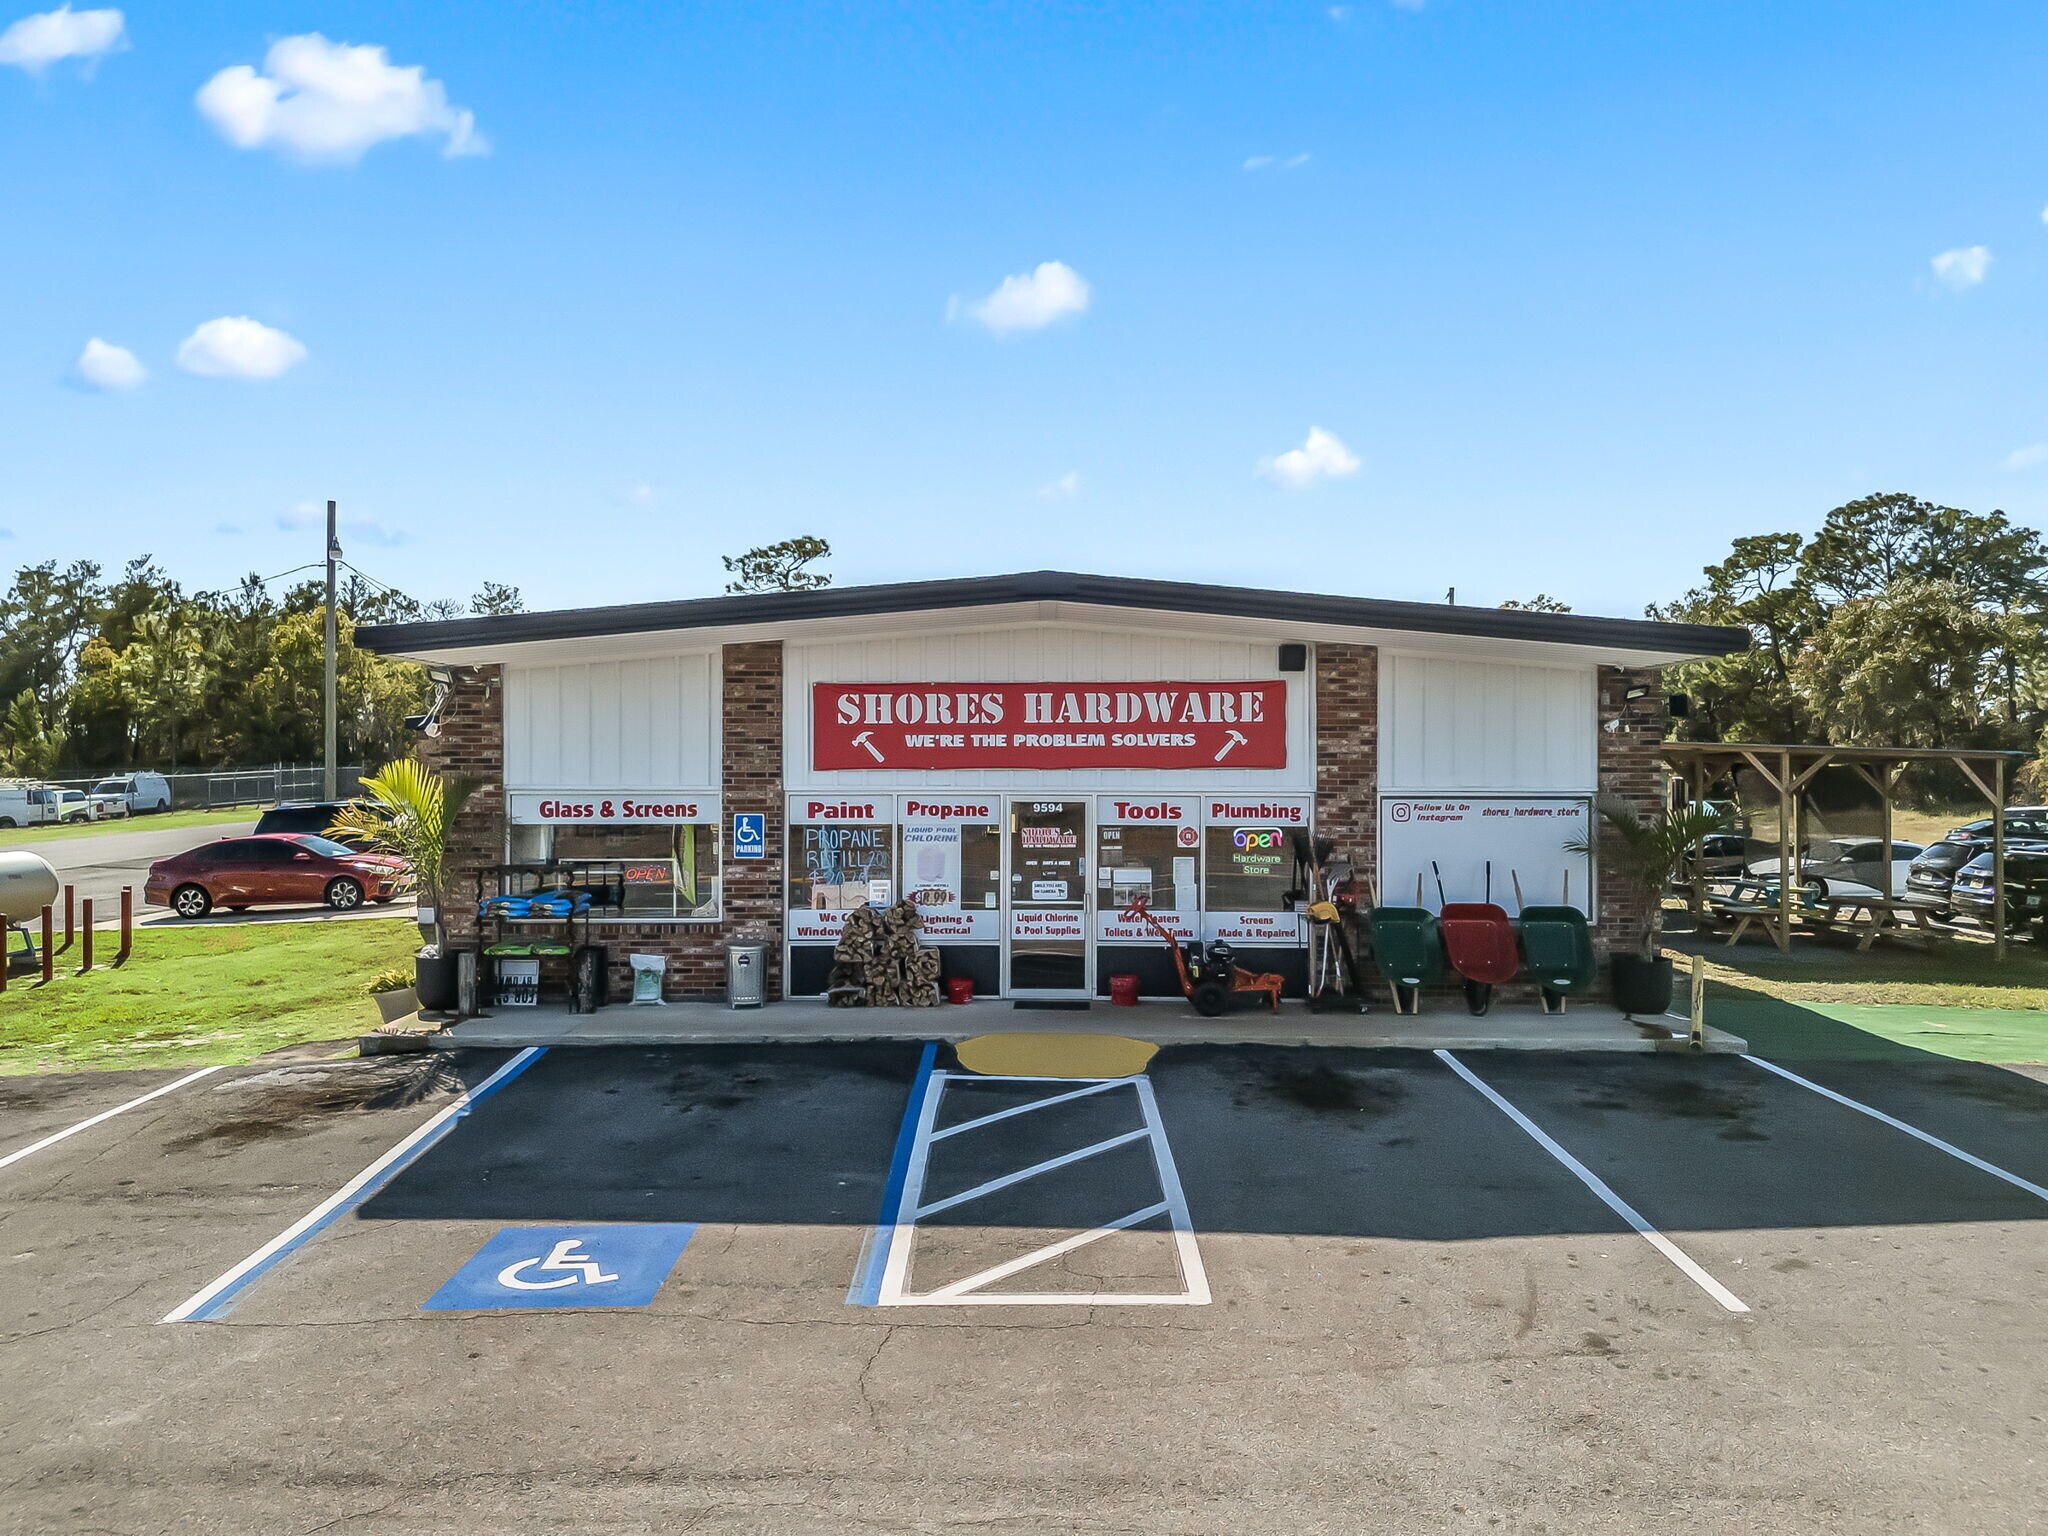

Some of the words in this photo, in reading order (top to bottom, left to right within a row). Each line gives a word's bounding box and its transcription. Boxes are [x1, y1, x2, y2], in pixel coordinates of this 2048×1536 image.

[837, 692, 1004, 725] SHORES
[1023, 691, 1264, 724] HARDWARE
[905, 734, 965, 748] WE'RE
[971, 734, 1008, 747] THE
[1013, 733, 1106, 747] PROBLEM
[1111, 733, 1197, 747] SOLVERS
[539, 800, 594, 818] Glass
[599, 800, 615, 818] &
[622, 800, 698, 818] Screens
[807, 801, 875, 819] Paint
[906, 801, 989, 820] Propane
[1033, 803, 1064, 813] 9594
[1113, 802, 1182, 819] Tools
[1211, 803, 1302, 822] Plumbing
[1413, 803, 1442, 811] Follow
[1445, 803, 1455, 811] Us
[1458, 803, 1471, 811] On
[1417, 813, 1464, 823] Instagram
[805, 828, 885, 849] PROPANE
[904, 834, 959, 842] CHLORINE
[1103, 831, 1121, 840] OPEN
[1233, 831, 1284, 853] open
[806, 849, 869, 870] REFILL
[1232, 853, 1281, 863] Hardware
[625, 867, 667, 880] OPEN
[1243, 865, 1270, 874] Store
[819, 912, 838, 923] We
[966, 915, 974, 923] &
[1016, 913, 1043, 923] Liquid
[1044, 913, 1079, 922] Chlorine
[1239, 915, 1274, 925] Screens
[923, 926, 971, 935] Electrical
[1015, 926, 1021, 935] &
[1024, 926, 1043, 935] Pool
[1045, 925, 1081, 937] Supplies
[1104, 927, 1133, 937] Toilets
[1136, 927, 1143, 937] &
[1168, 927, 1194, 937] Tanks
[1218, 928, 1243, 937] Made
[1246, 928, 1253, 937] &
[1255, 928, 1296, 939] Repaired
